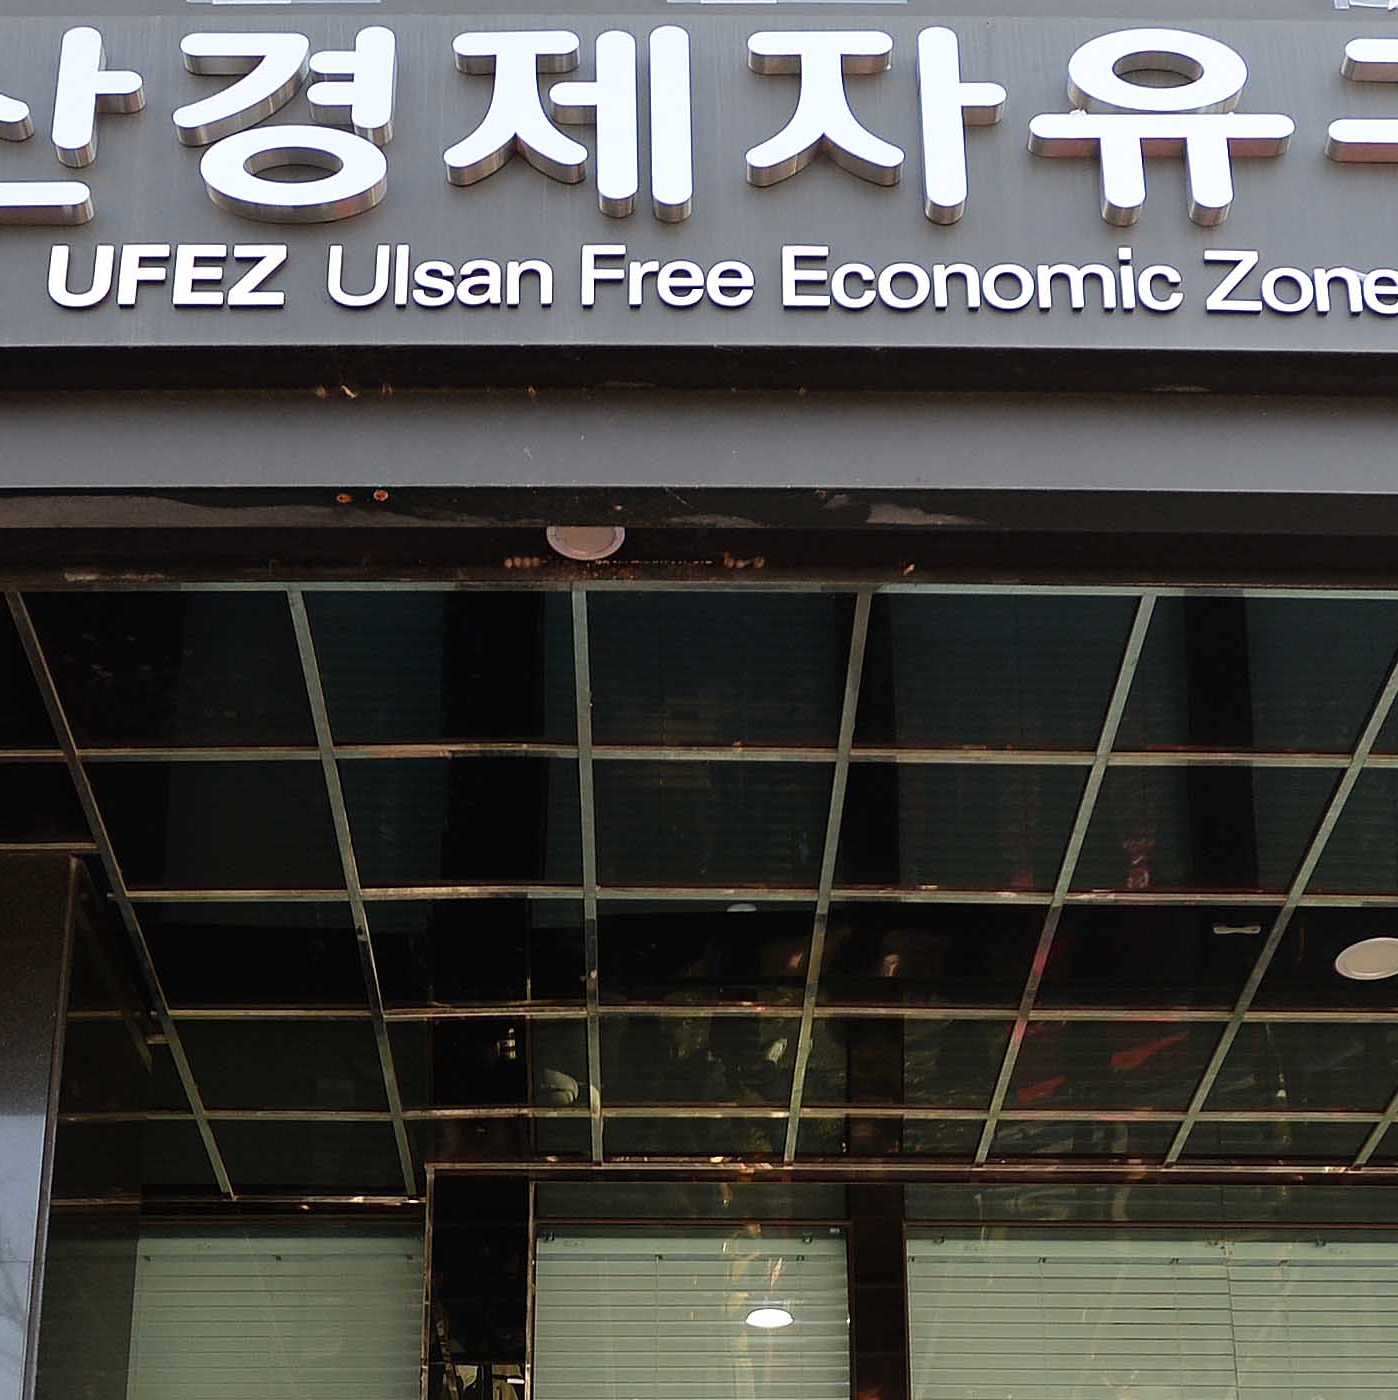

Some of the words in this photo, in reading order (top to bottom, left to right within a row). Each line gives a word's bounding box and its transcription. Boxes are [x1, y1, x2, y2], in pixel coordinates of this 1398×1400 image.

[47, 243, 288, 309] UFEZ
[327, 243, 554, 307] Ulsan
[580, 243, 755, 308] Free
[781, 244, 1185, 313] Economic
